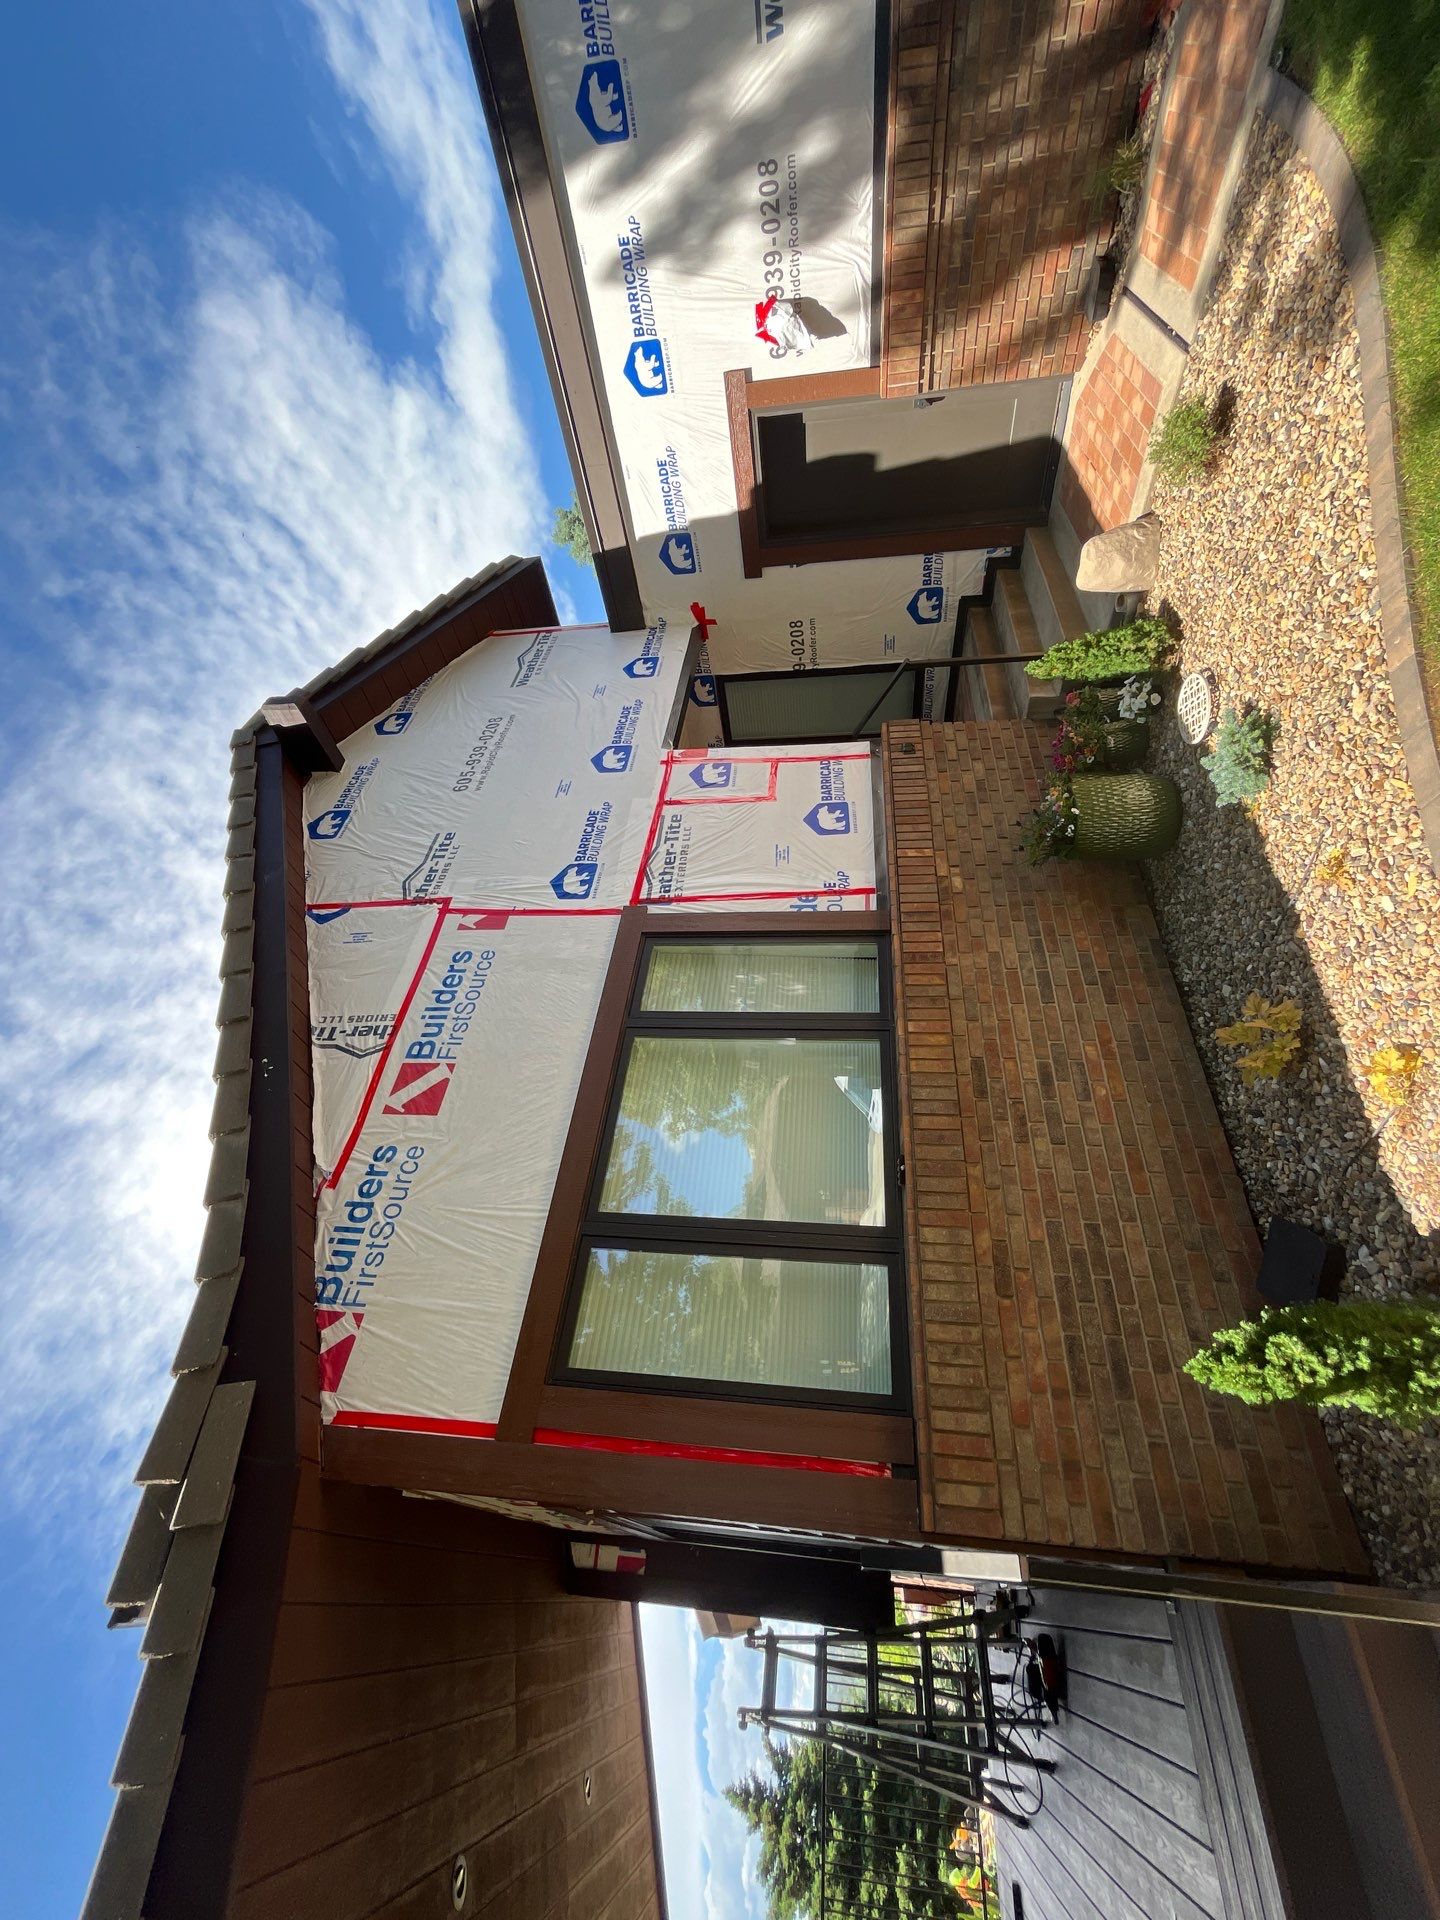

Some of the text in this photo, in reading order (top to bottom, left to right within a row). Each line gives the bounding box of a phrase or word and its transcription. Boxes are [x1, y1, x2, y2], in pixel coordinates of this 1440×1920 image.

[617, 236, 646, 337] BARRICADE
[628, 215, 658, 337] BUILDING WRAP
[656, 459, 678, 532] BARRICADE
[665, 445, 689, 532] BUILDING WRAP
[657, 617, 668, 635] WRAP
[611, 705, 632, 744] BARRICADE
[630, 699, 644, 716] WRAP
[923, 683, 934, 719] BUILDING
[452, 717, 503, 792] 605-939-0208
[622, 716, 640, 745] BUILDING
[333, 765, 368, 809] BARRICADE
[343, 777, 370, 809] BUILDING
[364, 757, 380, 777] WRAP
[832, 767, 846, 802] BUILDING
[447, 843, 461, 860] LLC
[574, 810, 600, 862] BARRICADE
[586, 801, 613, 862] BUILDING WRAP
[673, 826, 693, 898] EXTERIORS LLC
[318, 1015, 343, 1023] LLC
[405, 950, 473, 1059] Builders
[436, 949, 496, 1060] FirstSource
[315, 1145, 398, 1305] Builders
[340, 1145, 425, 1308] FirstSource
